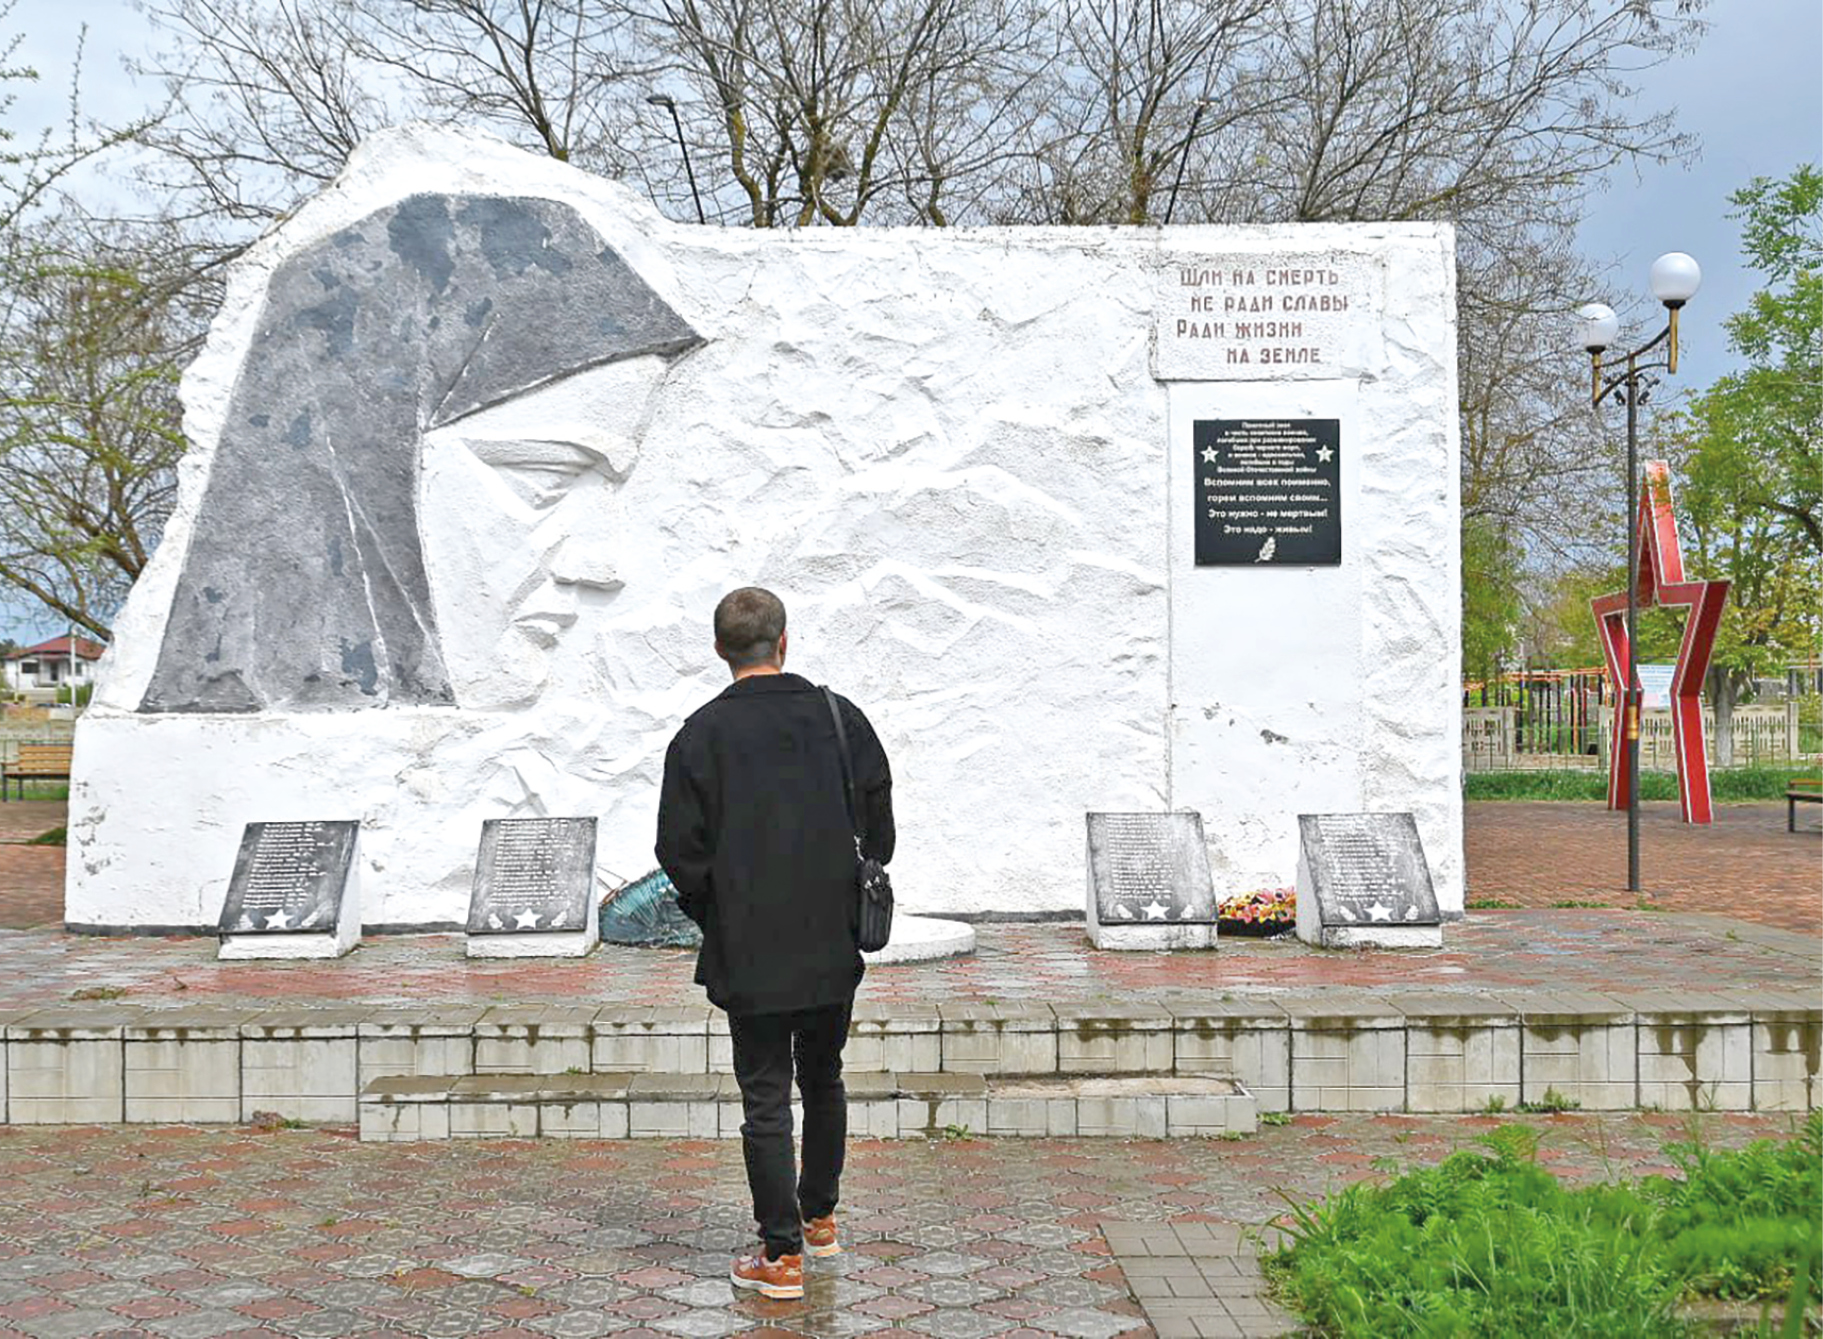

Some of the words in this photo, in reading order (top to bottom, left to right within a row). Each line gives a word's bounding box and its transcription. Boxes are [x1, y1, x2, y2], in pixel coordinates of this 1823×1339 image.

[1180, 268, 1223, 287] ШЛИ
[1233, 269, 1255, 286] НА
[1266, 269, 1339, 286] СМЕРТЬ
[1191, 296, 1213, 312] НЕ
[1224, 296, 1273, 312] РАДИ
[1283, 295, 1349, 312] СЛАВЫ
[1235, 321, 1302, 339] ЖИЗНИ
[1227, 348, 1249, 364] НА
[1260, 347, 1321, 364] ЗЕМЛЕ
[1204, 478, 1254, 487] Вспомним
[1208, 510, 1226, 518] Это
[1229, 511, 1258, 519] нужно
[1224, 525, 1241, 533] Это
[1244, 526, 1267, 534] надо
